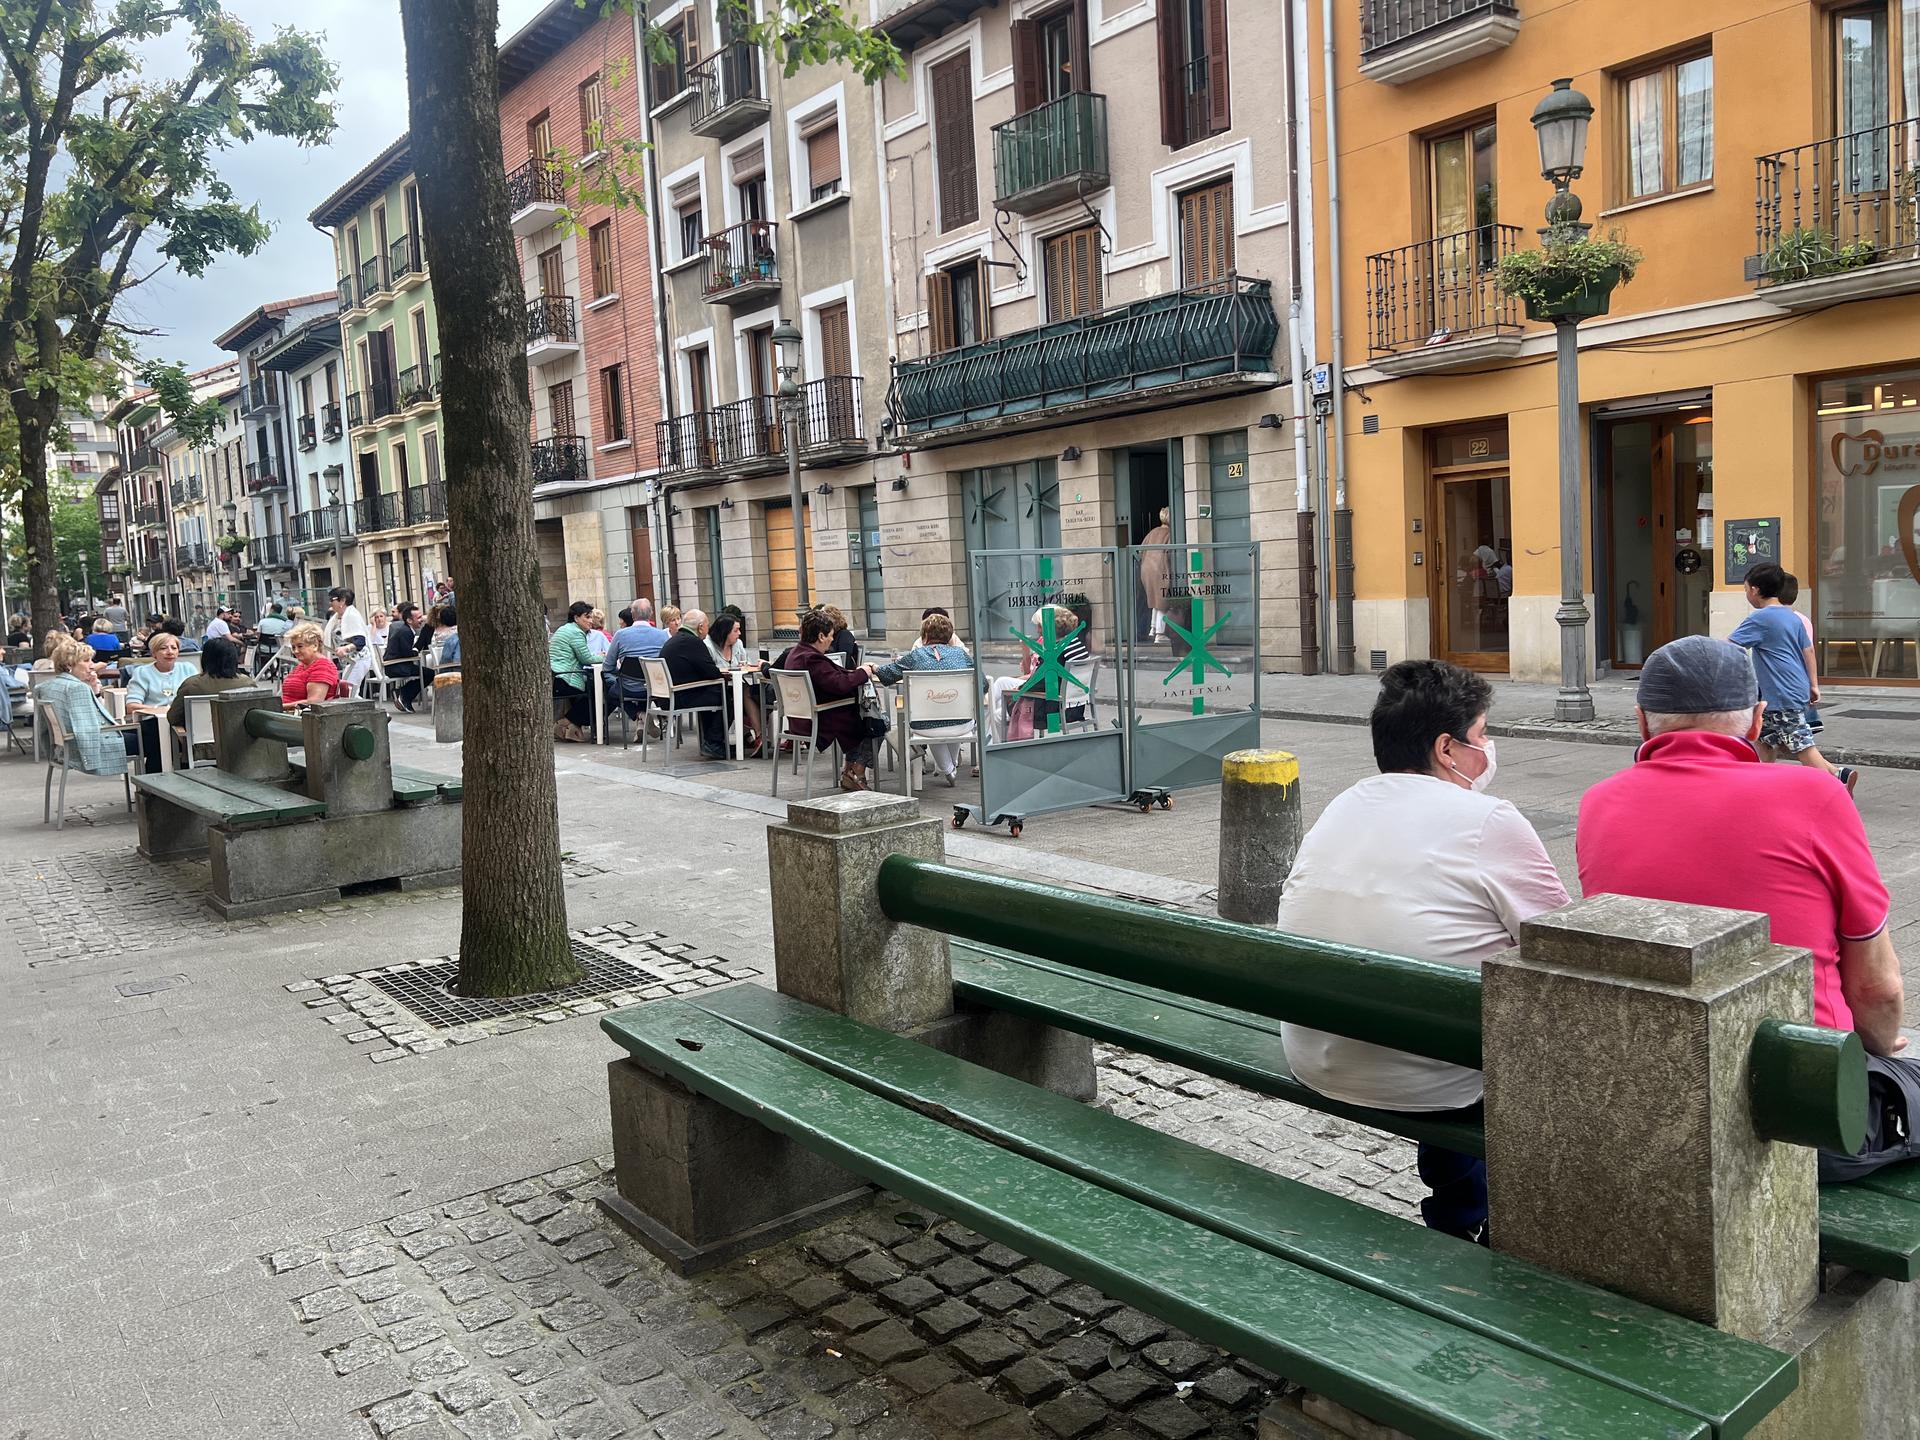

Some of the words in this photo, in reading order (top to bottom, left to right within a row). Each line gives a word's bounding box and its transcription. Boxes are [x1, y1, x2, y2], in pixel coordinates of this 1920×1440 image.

[1472, 441, 1488, 455] 22
[1229, 464, 1242, 477] 24
[1162, 571, 1231, 580] RESTAURANTE
[1161, 584, 1231, 598] TABERNA-BERRI
[1163, 685, 1232, 698] JATETXEA
